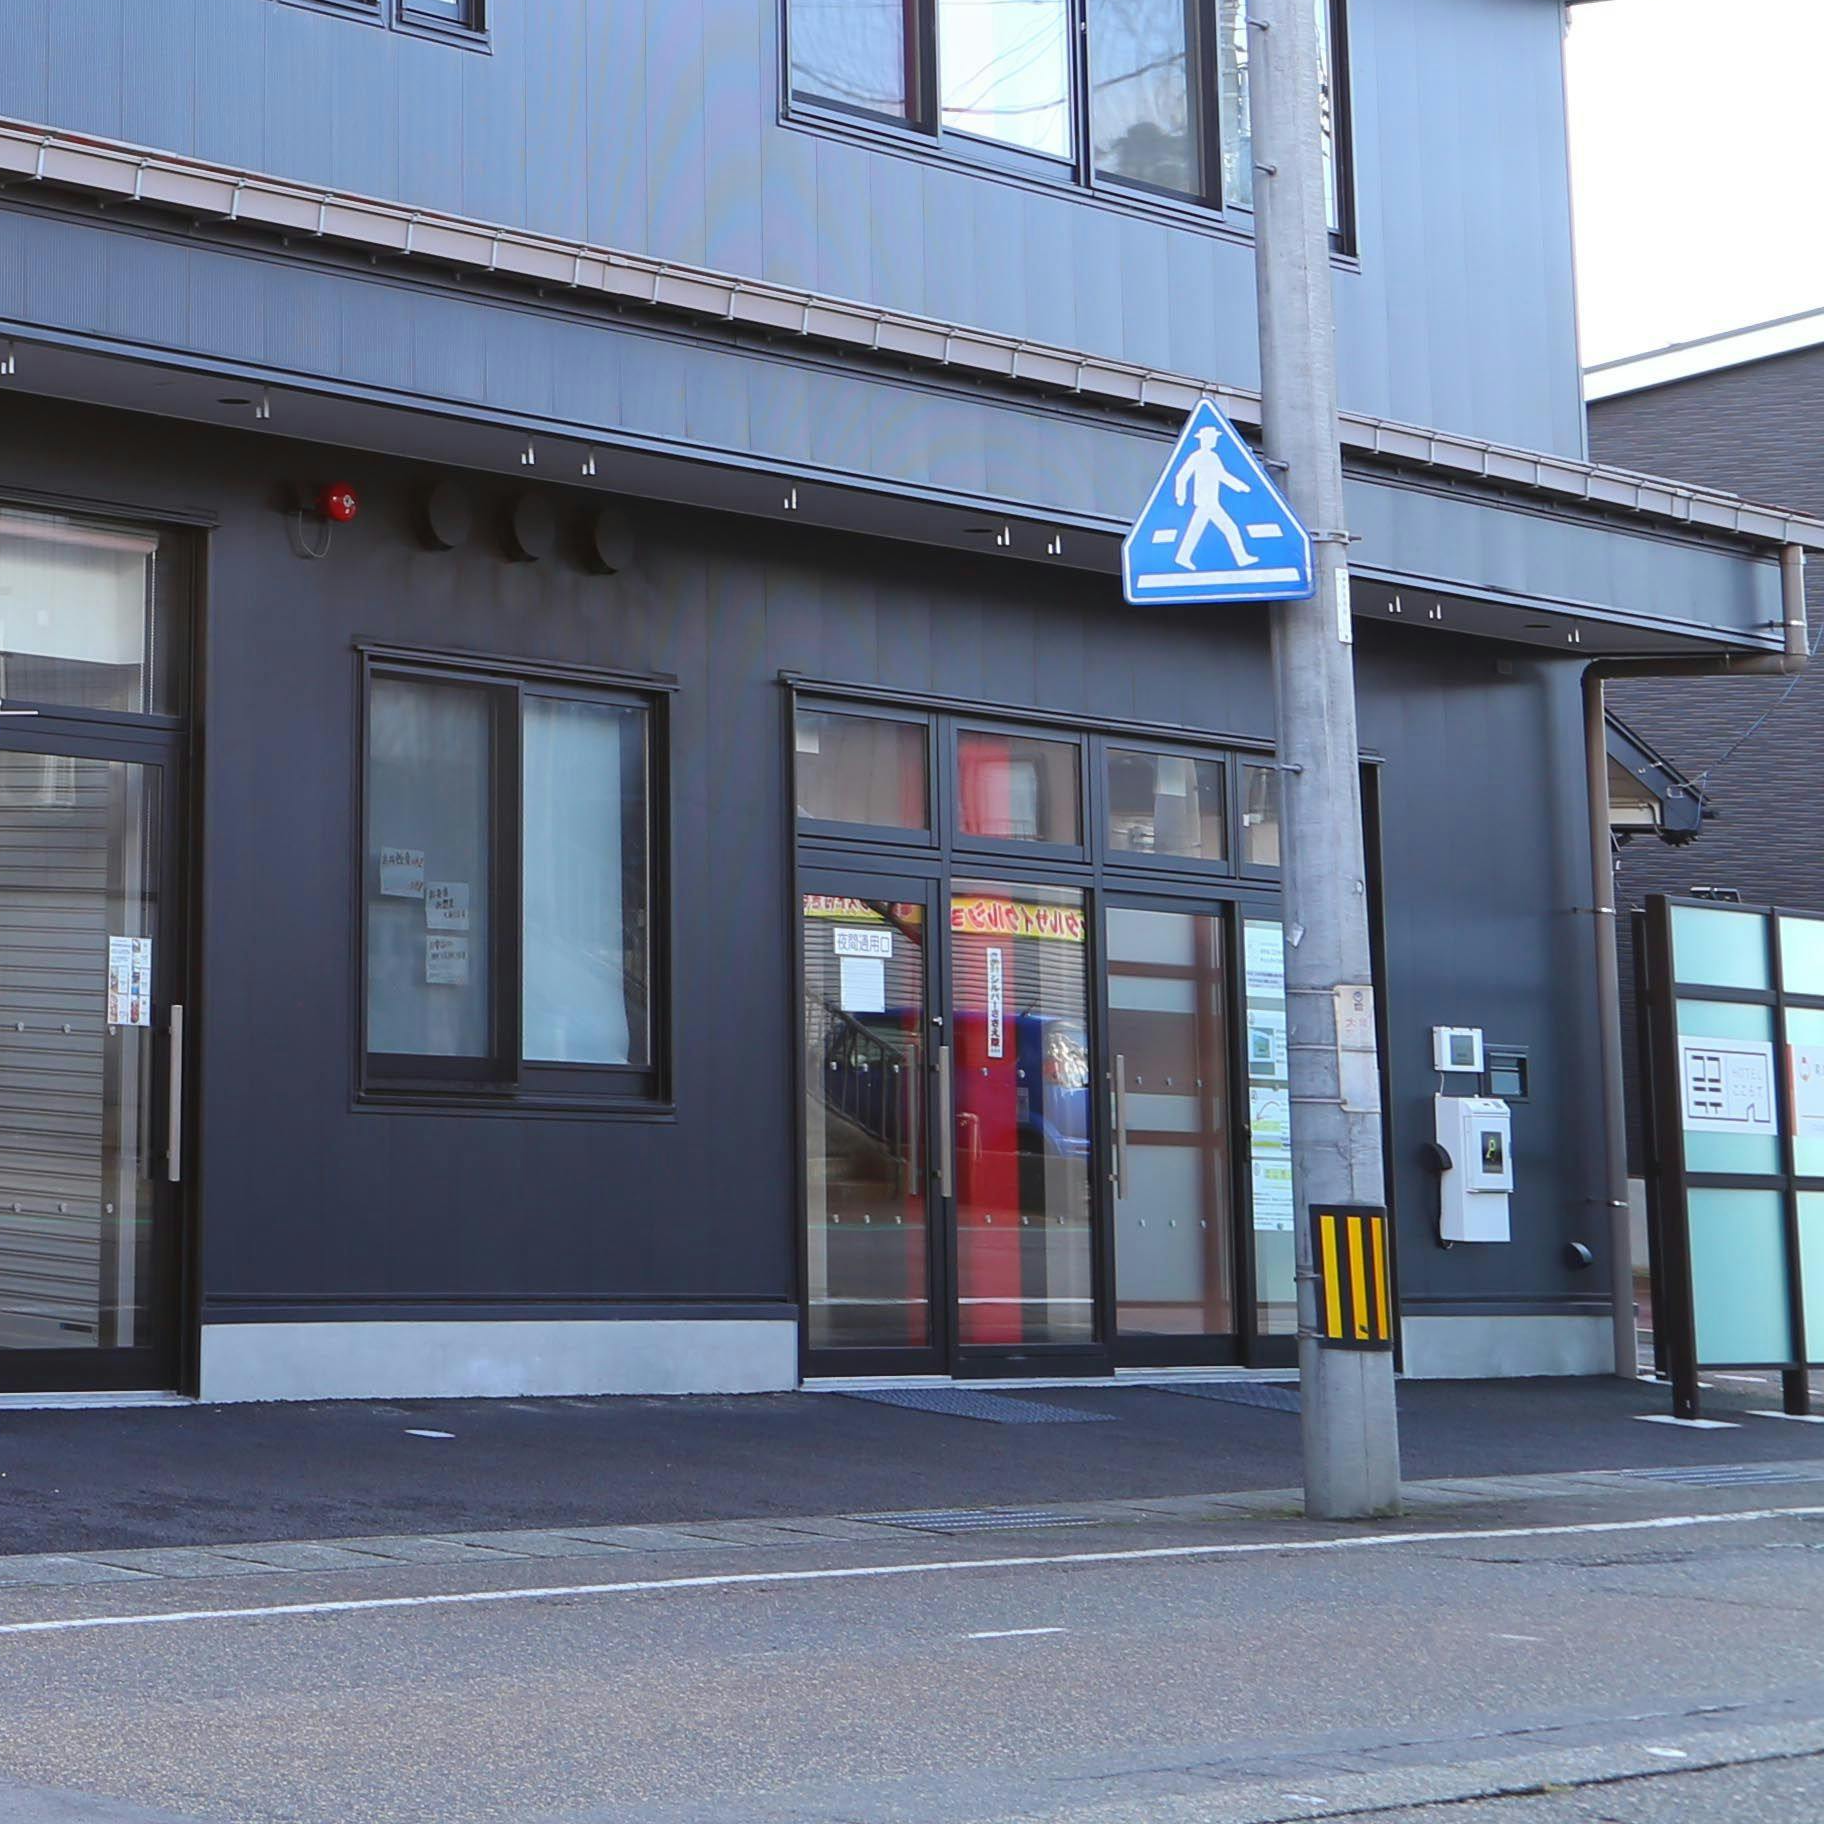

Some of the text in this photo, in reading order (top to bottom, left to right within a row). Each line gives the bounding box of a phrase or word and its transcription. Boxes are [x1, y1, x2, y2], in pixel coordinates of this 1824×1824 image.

[836, 932, 890, 953] 夜間通用口
